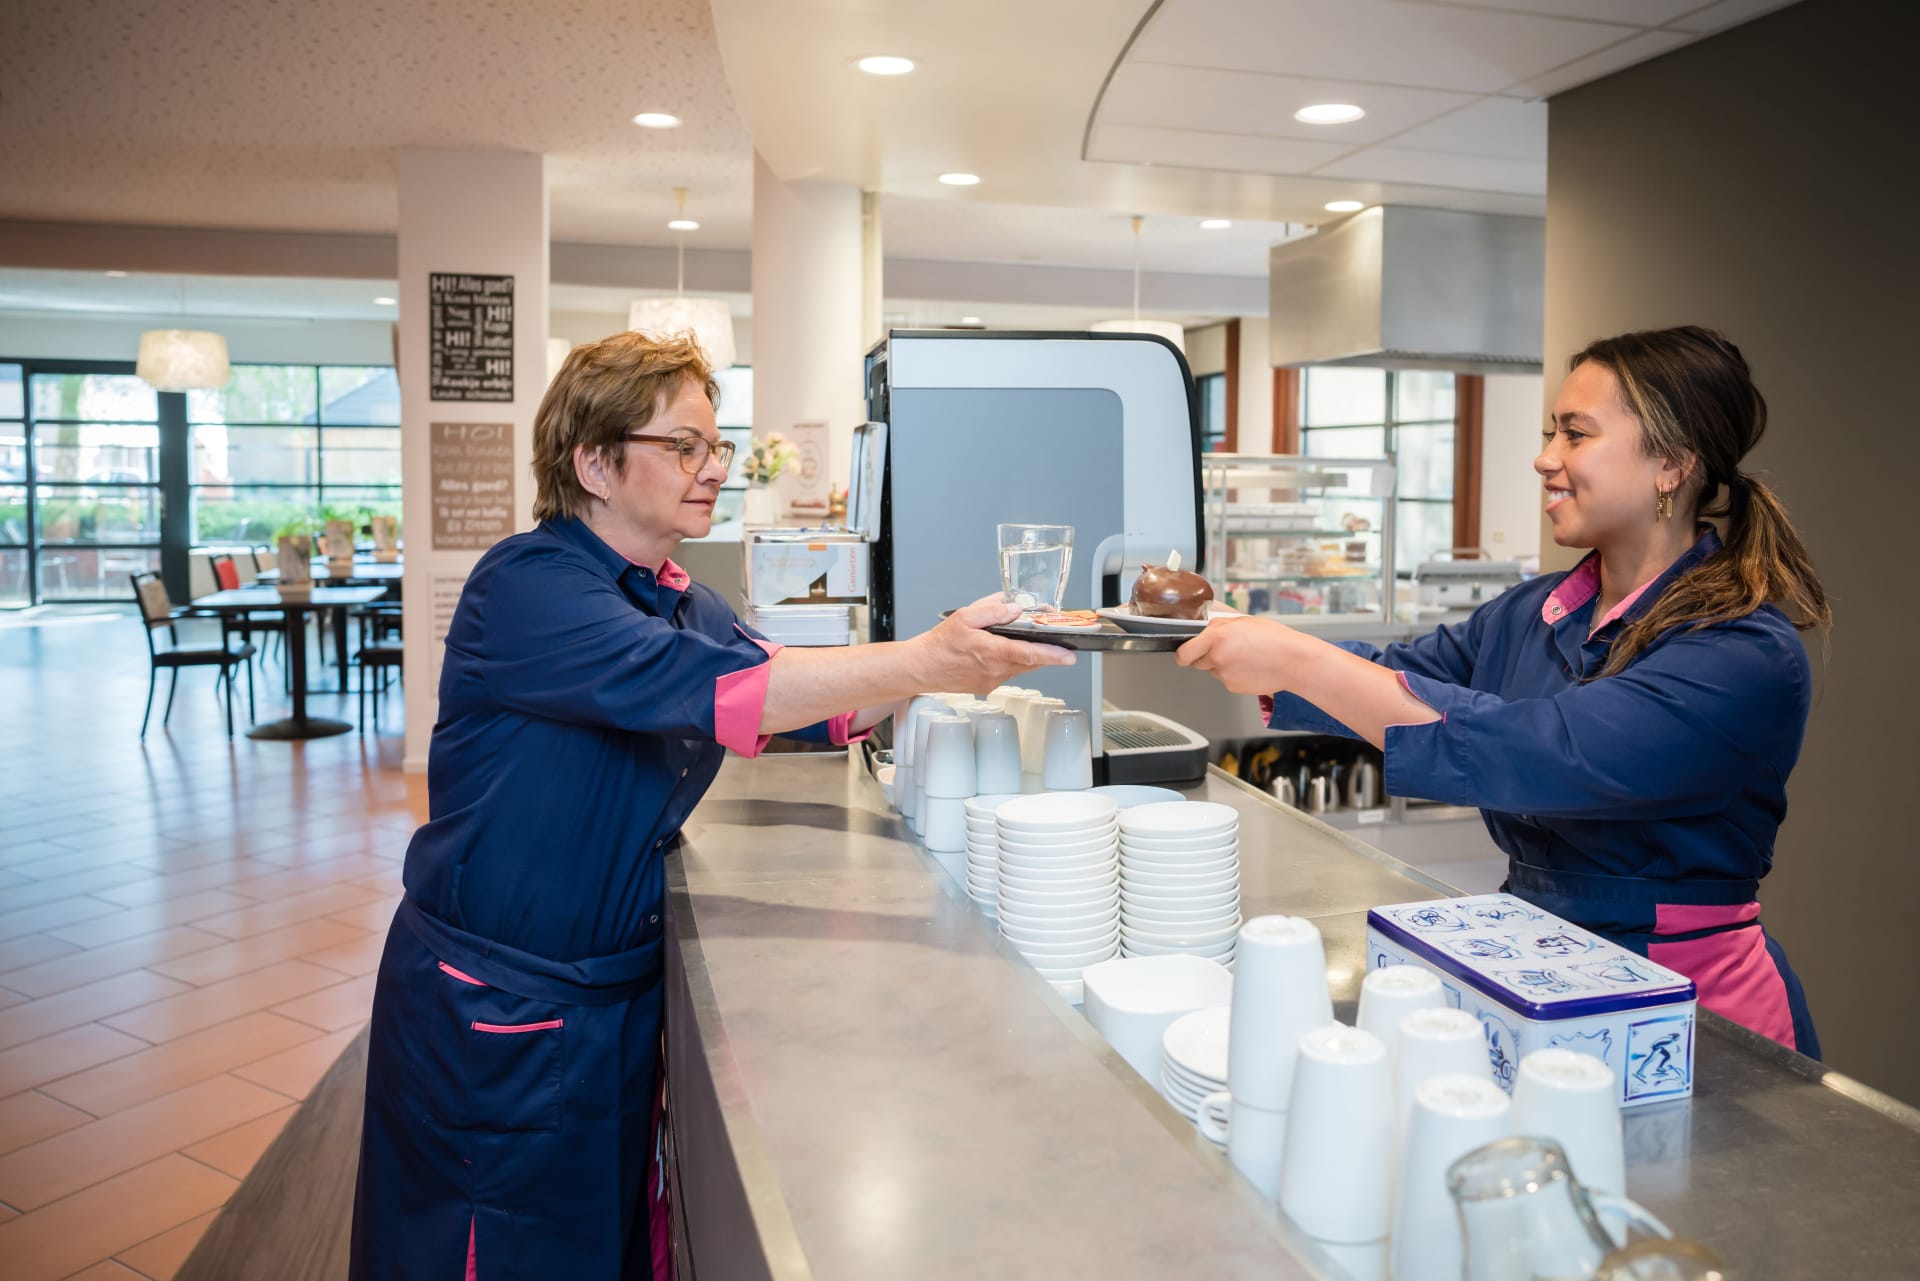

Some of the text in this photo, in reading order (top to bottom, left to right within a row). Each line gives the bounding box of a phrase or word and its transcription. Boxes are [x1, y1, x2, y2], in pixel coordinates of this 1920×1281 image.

[432, 275, 457, 292] HI!
[487, 306, 512, 321] HI!
[446, 331, 471, 346] HI!
[486, 359, 511, 376] HI!
